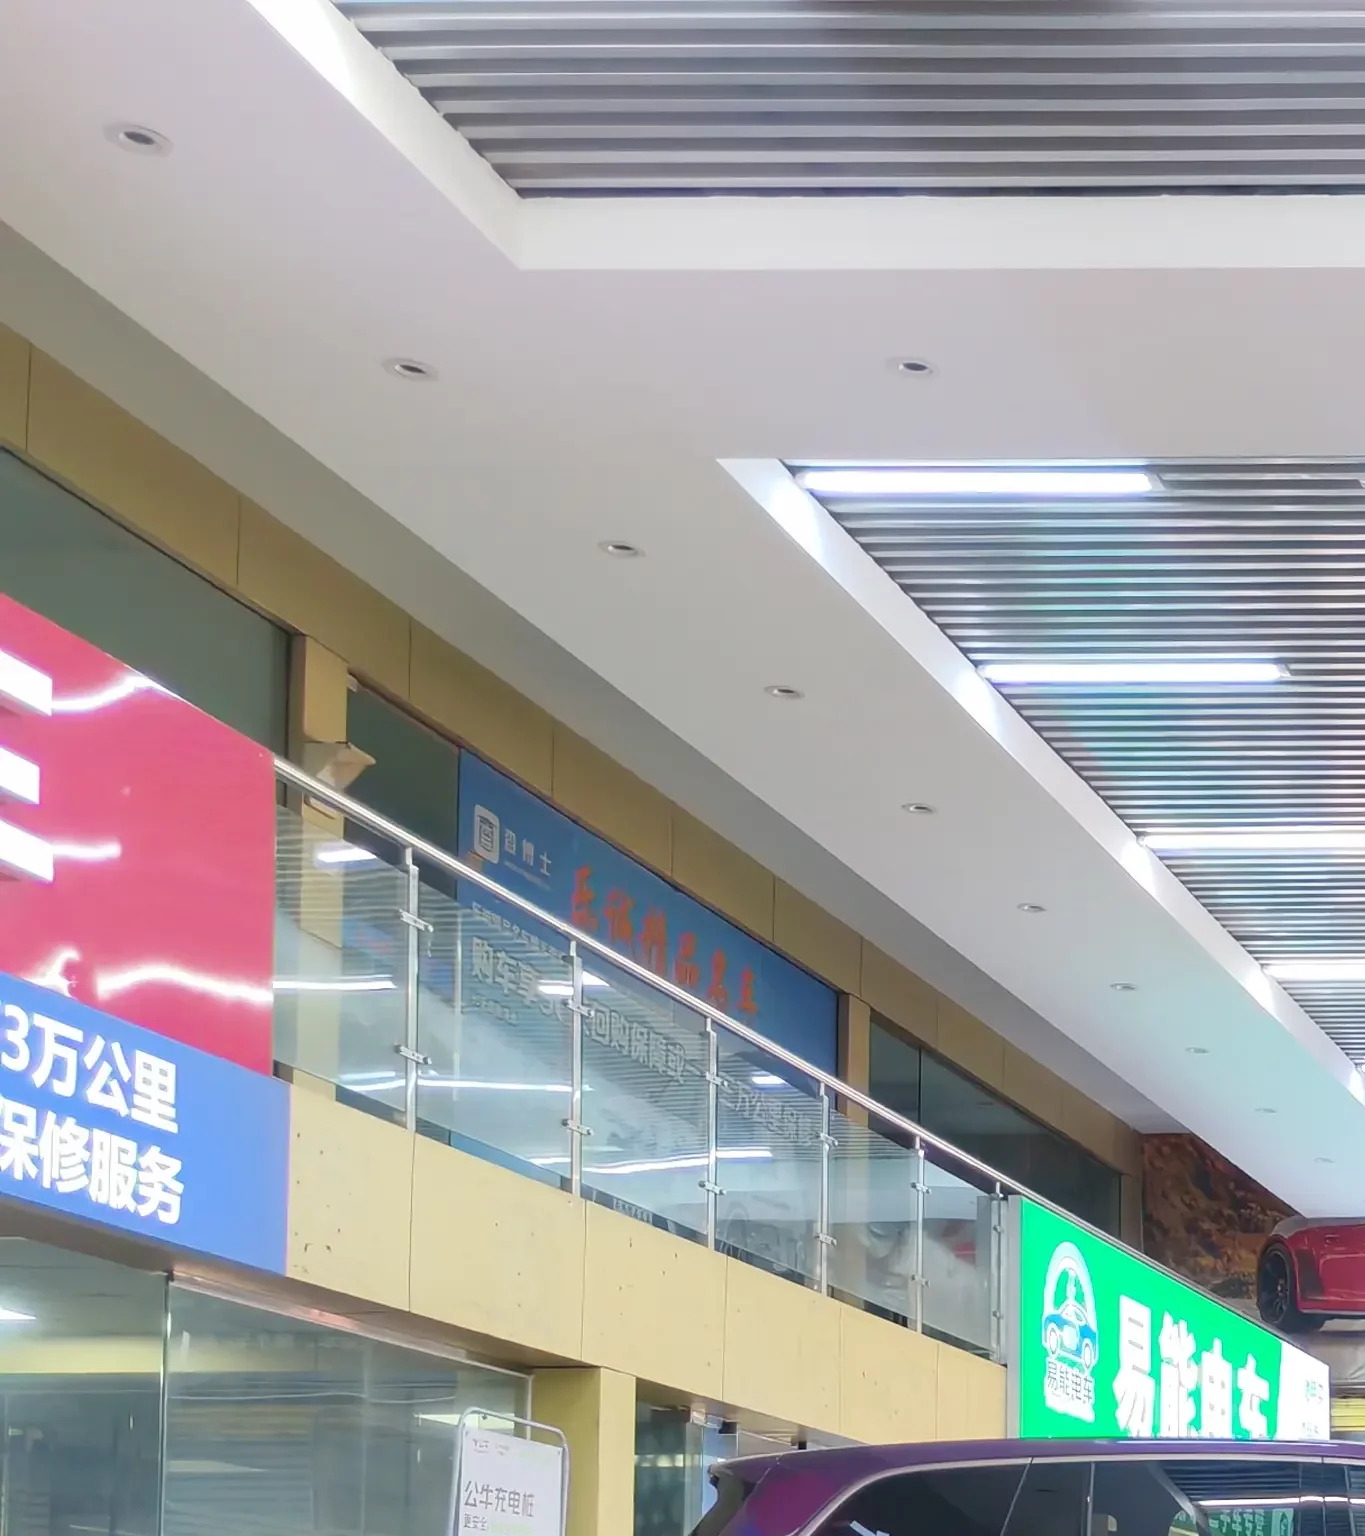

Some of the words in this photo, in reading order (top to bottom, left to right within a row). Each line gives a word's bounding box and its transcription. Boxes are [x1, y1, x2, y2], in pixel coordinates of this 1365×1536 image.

[0, 1003, 179, 1134] 3万公里
[464, 1480, 535, 1518] 公牛充电桩
